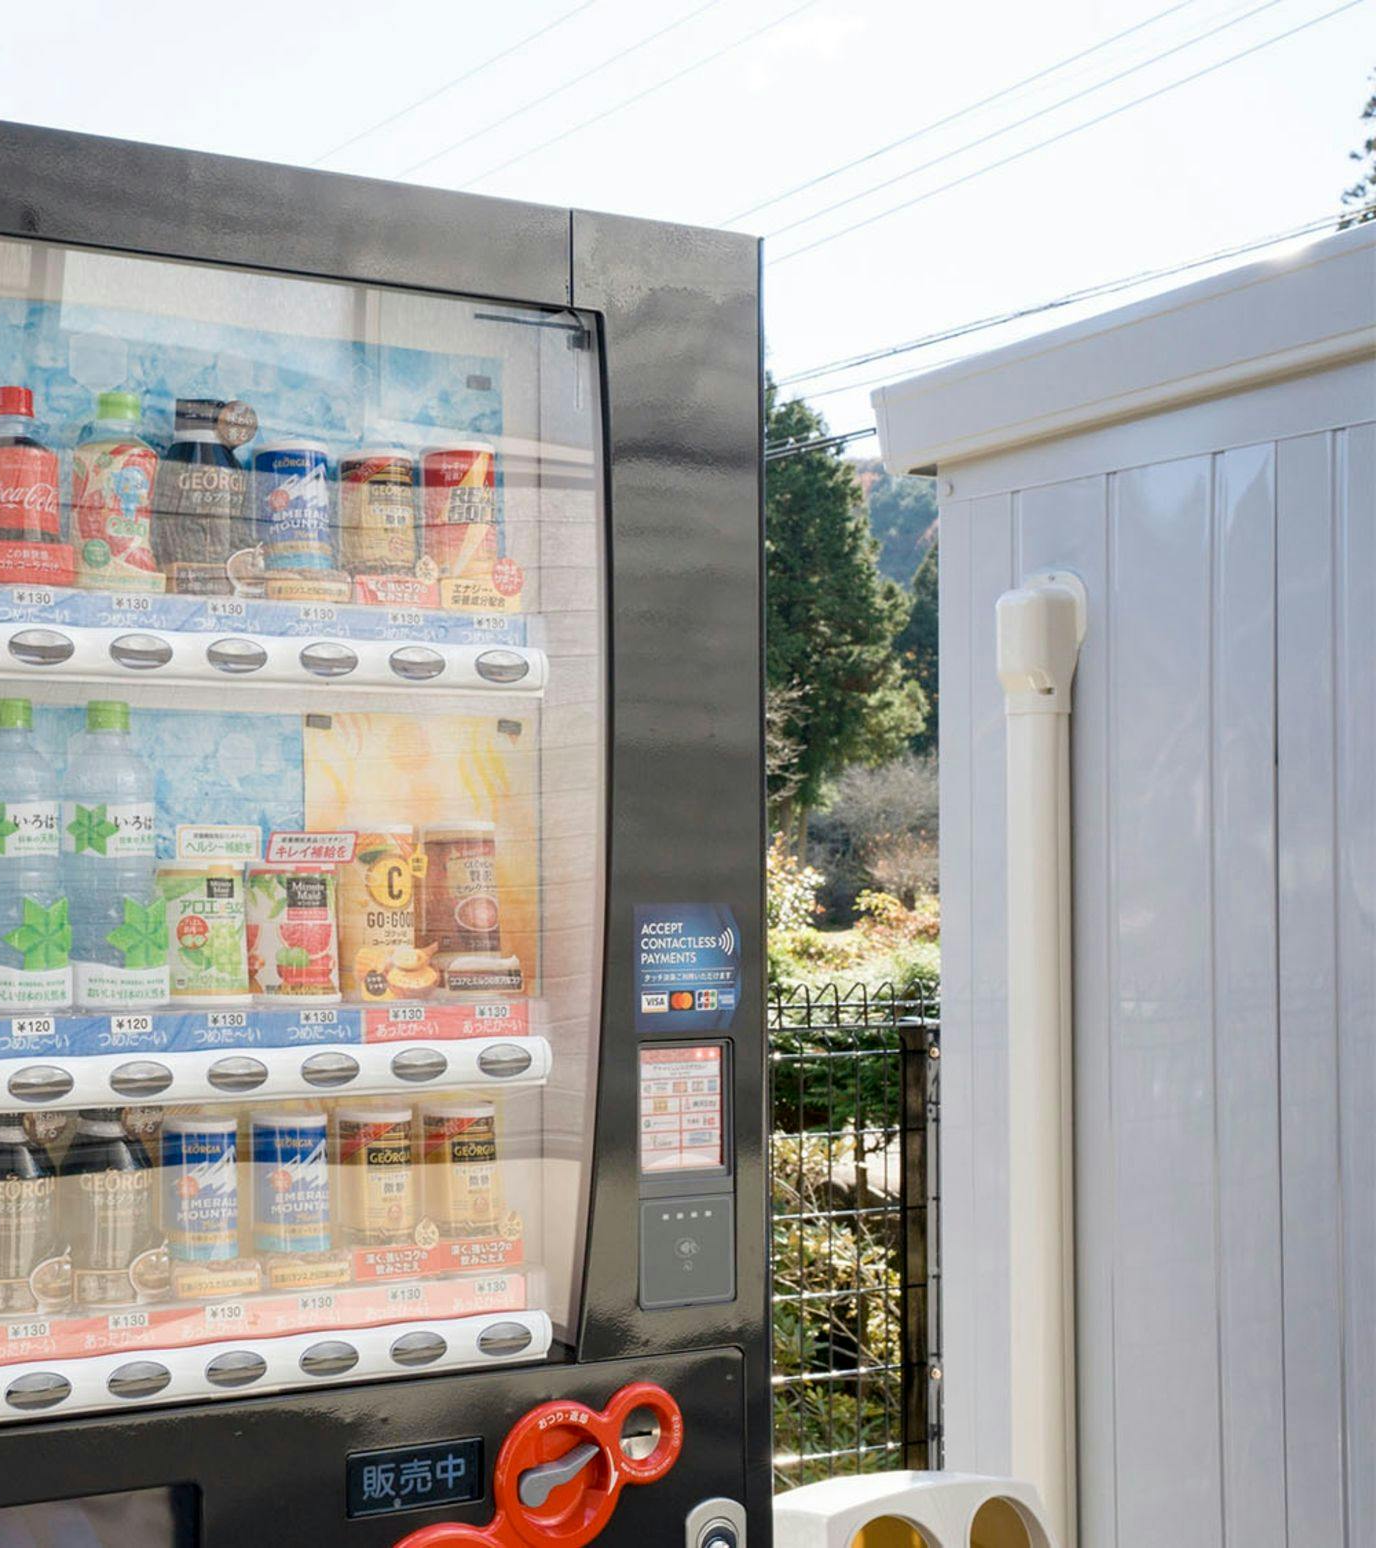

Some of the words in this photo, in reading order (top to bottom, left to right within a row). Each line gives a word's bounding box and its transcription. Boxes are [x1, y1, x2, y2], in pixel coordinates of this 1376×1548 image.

[179, 467, 247, 492] GEORGI
[273, 509, 330, 523] EMERAL
[17, 593, 51, 604] ¥130
[116, 599, 148, 610] ¥130
[211, 603, 243, 614] ¥130
[303, 607, 333, 619] ¥130
[391, 614, 421, 626] ¥130
[476, 619, 505, 630] ¥130
[13, 814, 56, 829] いろは
[114, 815, 154, 830] いろは
[387, 866, 404, 900] C
[641, 922, 683, 935] ACCEPT
[640, 936, 716, 949] CONTACTLESS
[641, 952, 696, 964] PAYMENTS
[645, 997, 665, 1006] VISA
[303, 1011, 334, 1023] ¥130
[392, 1009, 422, 1020] ¥130
[478, 1006, 507, 1017] ¥130
[116, 1018, 149, 1030] ¥120
[211, 1014, 243, 1026] ¥130
[17, 1021, 50, 1033] ¥120
[80, 1167, 153, 1193] GEORGI
[275, 1190, 328, 1203] EMERAL
[181, 1197, 237, 1209] EMERAL
[177, 1209, 238, 1222] MOUNTA
[477, 1280, 506, 1293] ¥130
[390, 1289, 421, 1301] ¥130
[302, 1297, 332, 1309] ¥130
[210, 1306, 241, 1318] ¥130
[112, 1315, 146, 1326] ¥130
[11, 1324, 47, 1337] ¥130
[361, 1454, 467, 1501] 販売中
